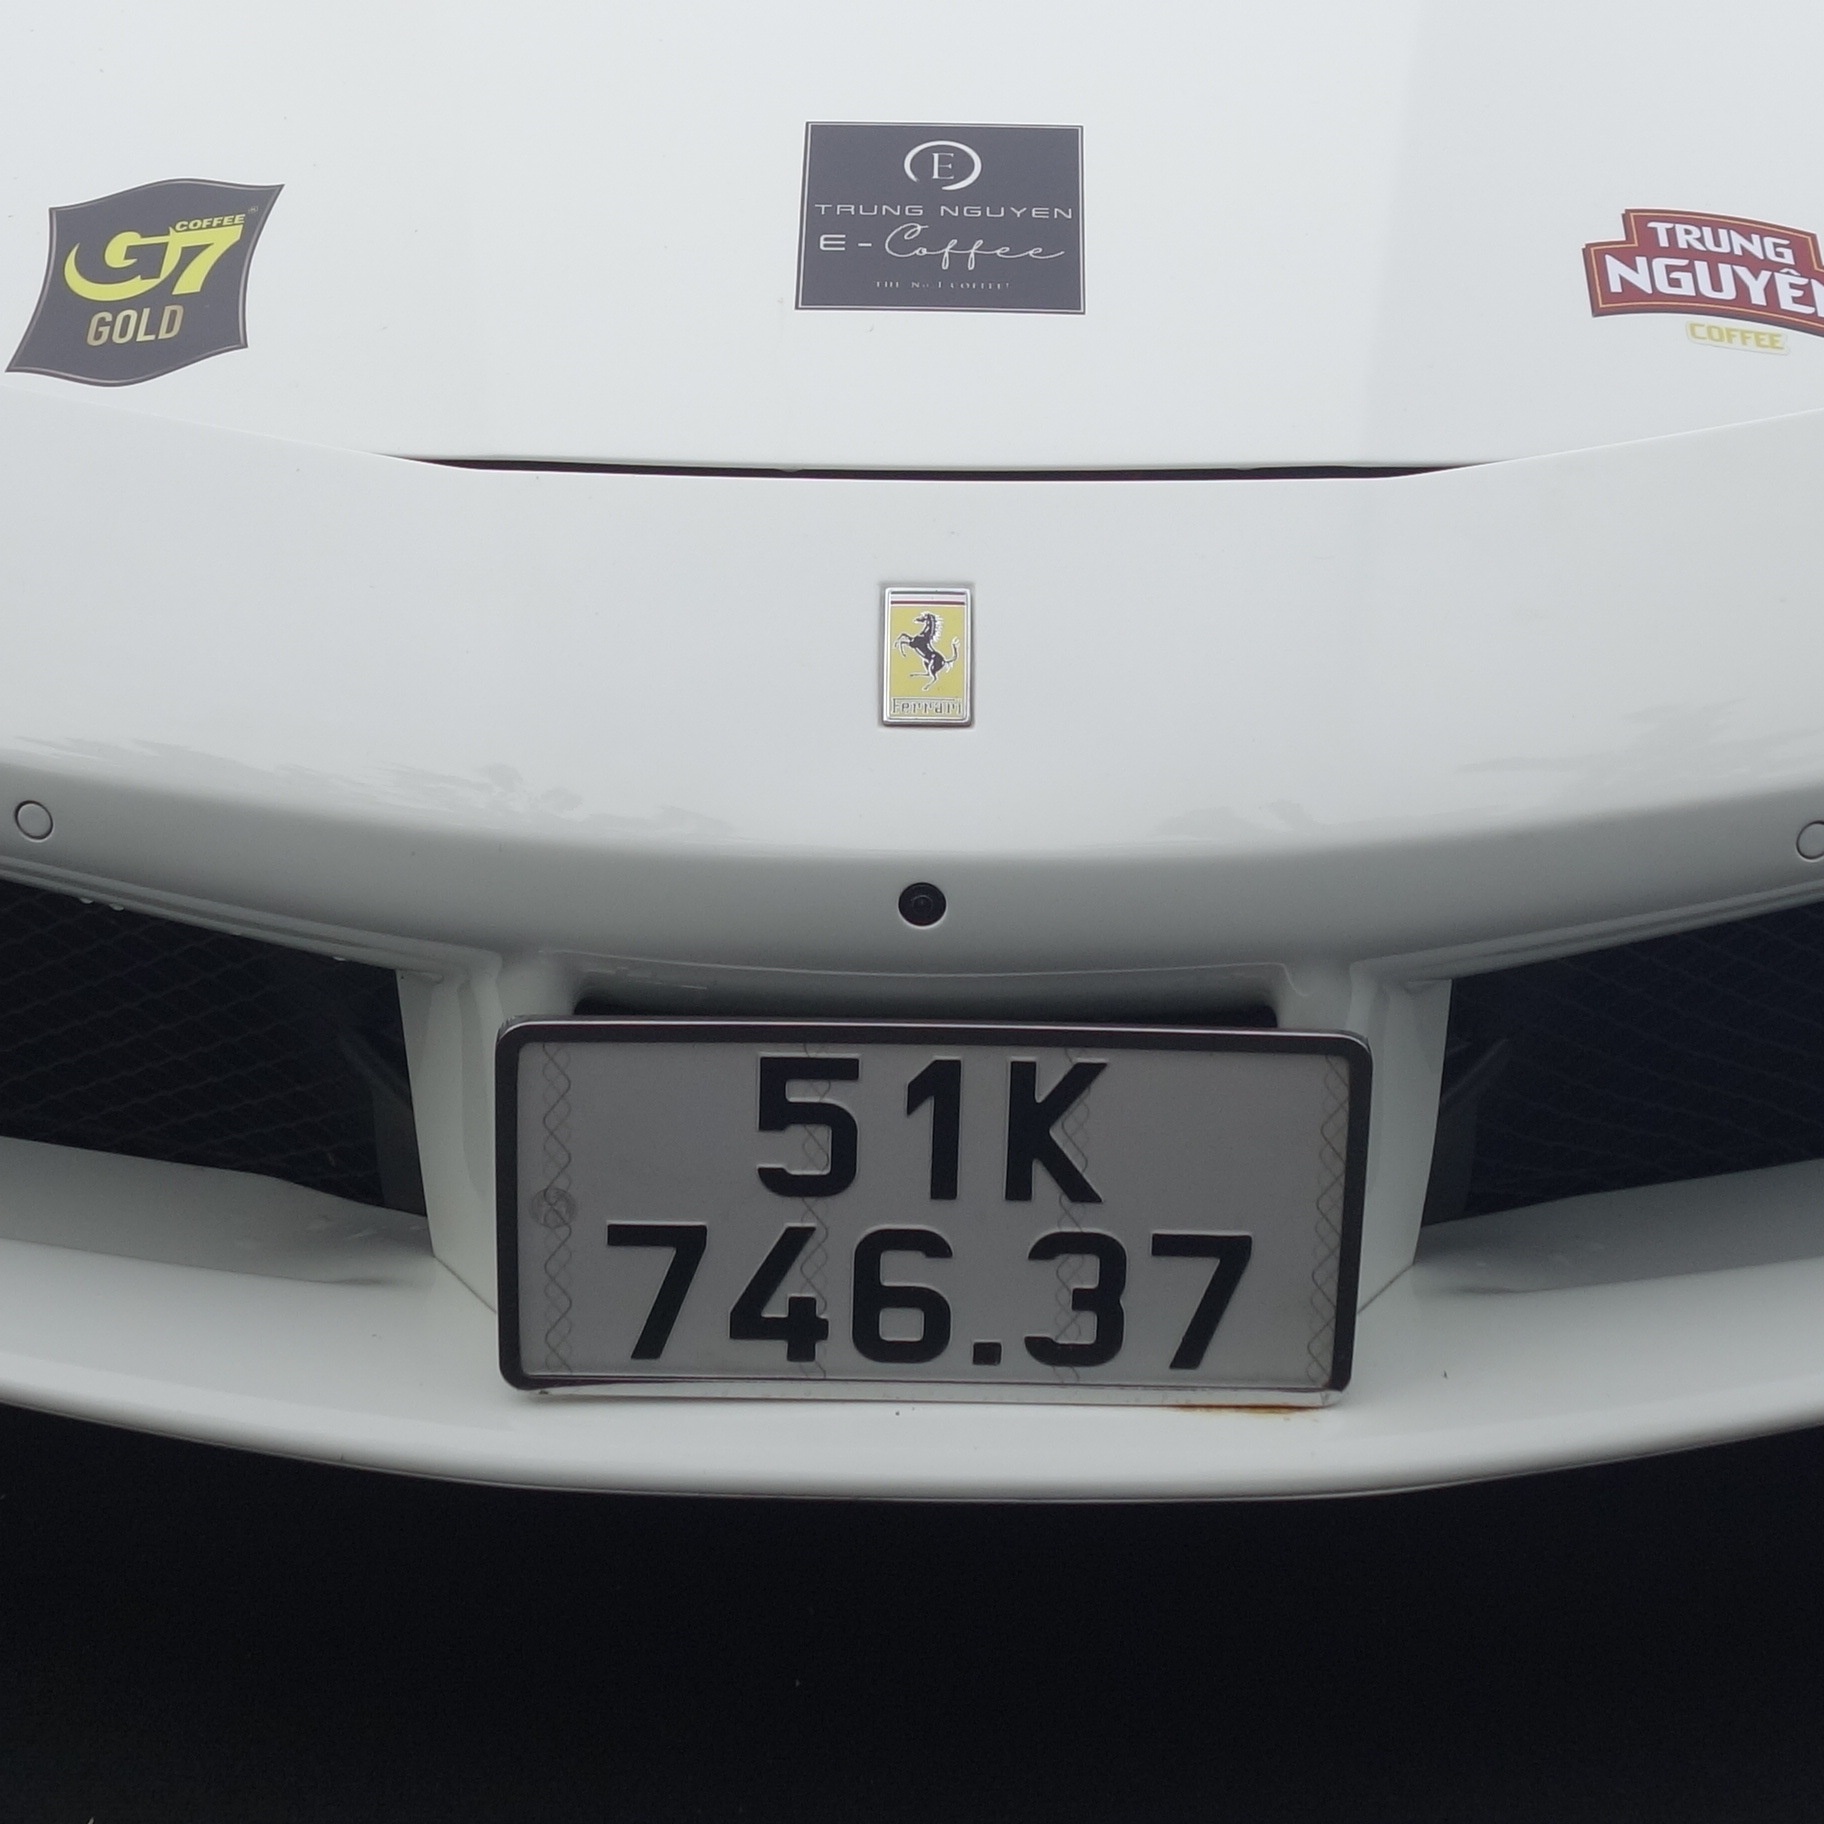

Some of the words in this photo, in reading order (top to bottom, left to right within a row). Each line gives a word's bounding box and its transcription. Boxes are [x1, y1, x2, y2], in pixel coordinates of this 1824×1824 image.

[175, 213, 246, 232] COFFEE
[814, 203, 924, 217] TRUNG
[940, 205, 1073, 219] NGUYEN
[63, 224, 244, 302] G7
[1647, 221, 1796, 266] TRUNG
[86, 304, 184, 347] GOLD
[1689, 322, 1785, 351] COFFEE
[892, 697, 963, 716] Ferrari
[756, 1054, 1109, 1203] 51K
[606, 1221, 1253, 1371] 746.37
